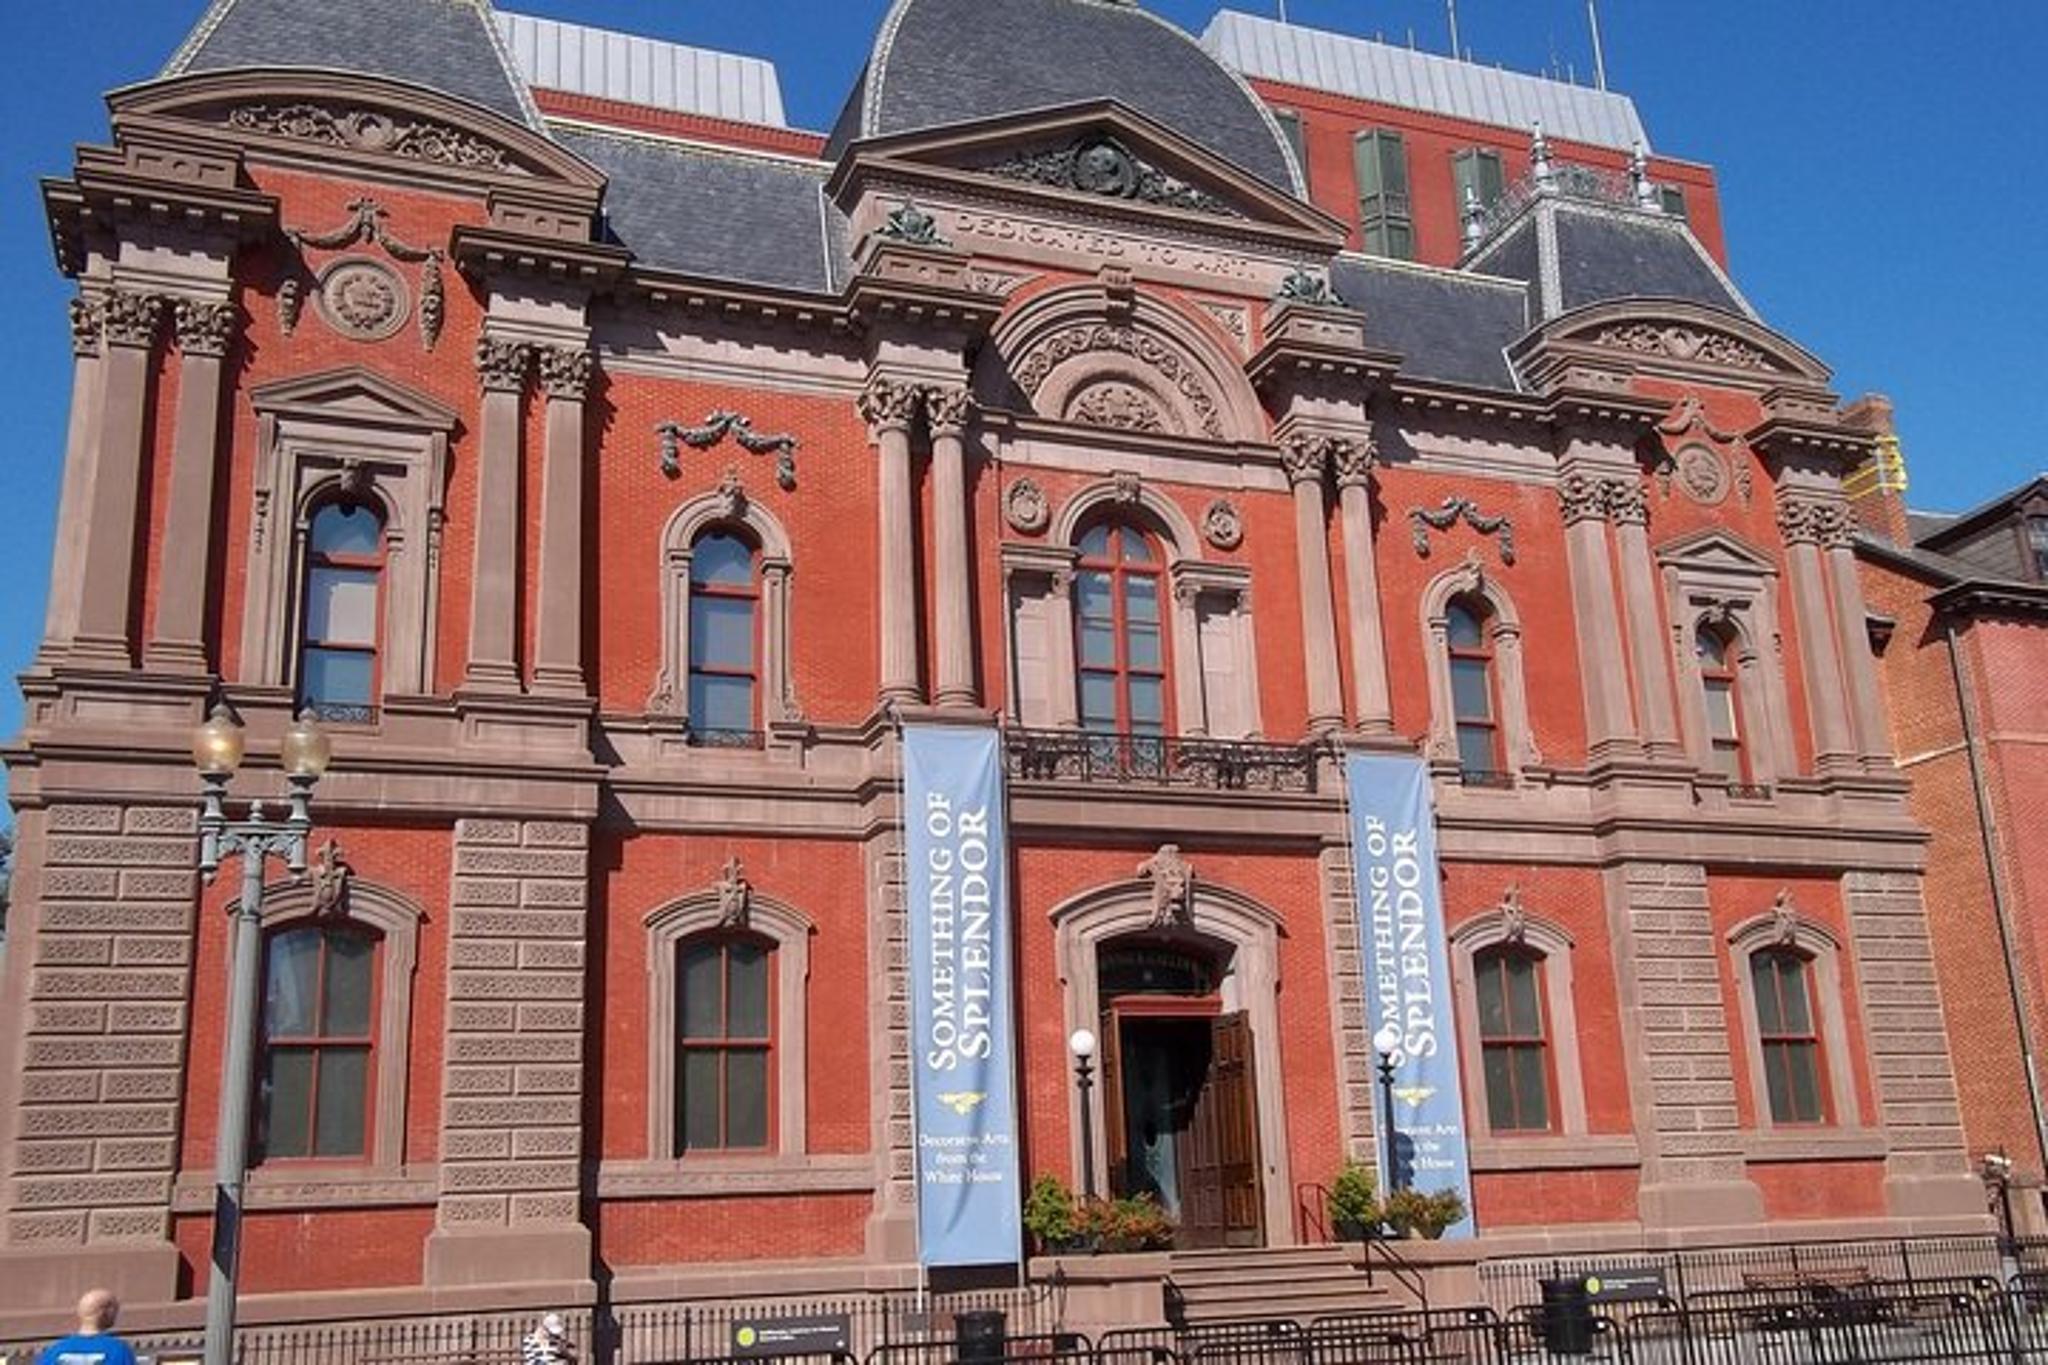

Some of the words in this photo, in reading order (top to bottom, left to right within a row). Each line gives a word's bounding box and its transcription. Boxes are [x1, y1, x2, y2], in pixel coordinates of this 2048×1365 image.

[927, 791, 952, 837] OF
[1365, 815, 1386, 857] OF
[926, 847, 956, 1071] SOMETHING
[957, 804, 991, 1059] SPLENDOR
[1393, 827, 1437, 1057] SPLENDOR
